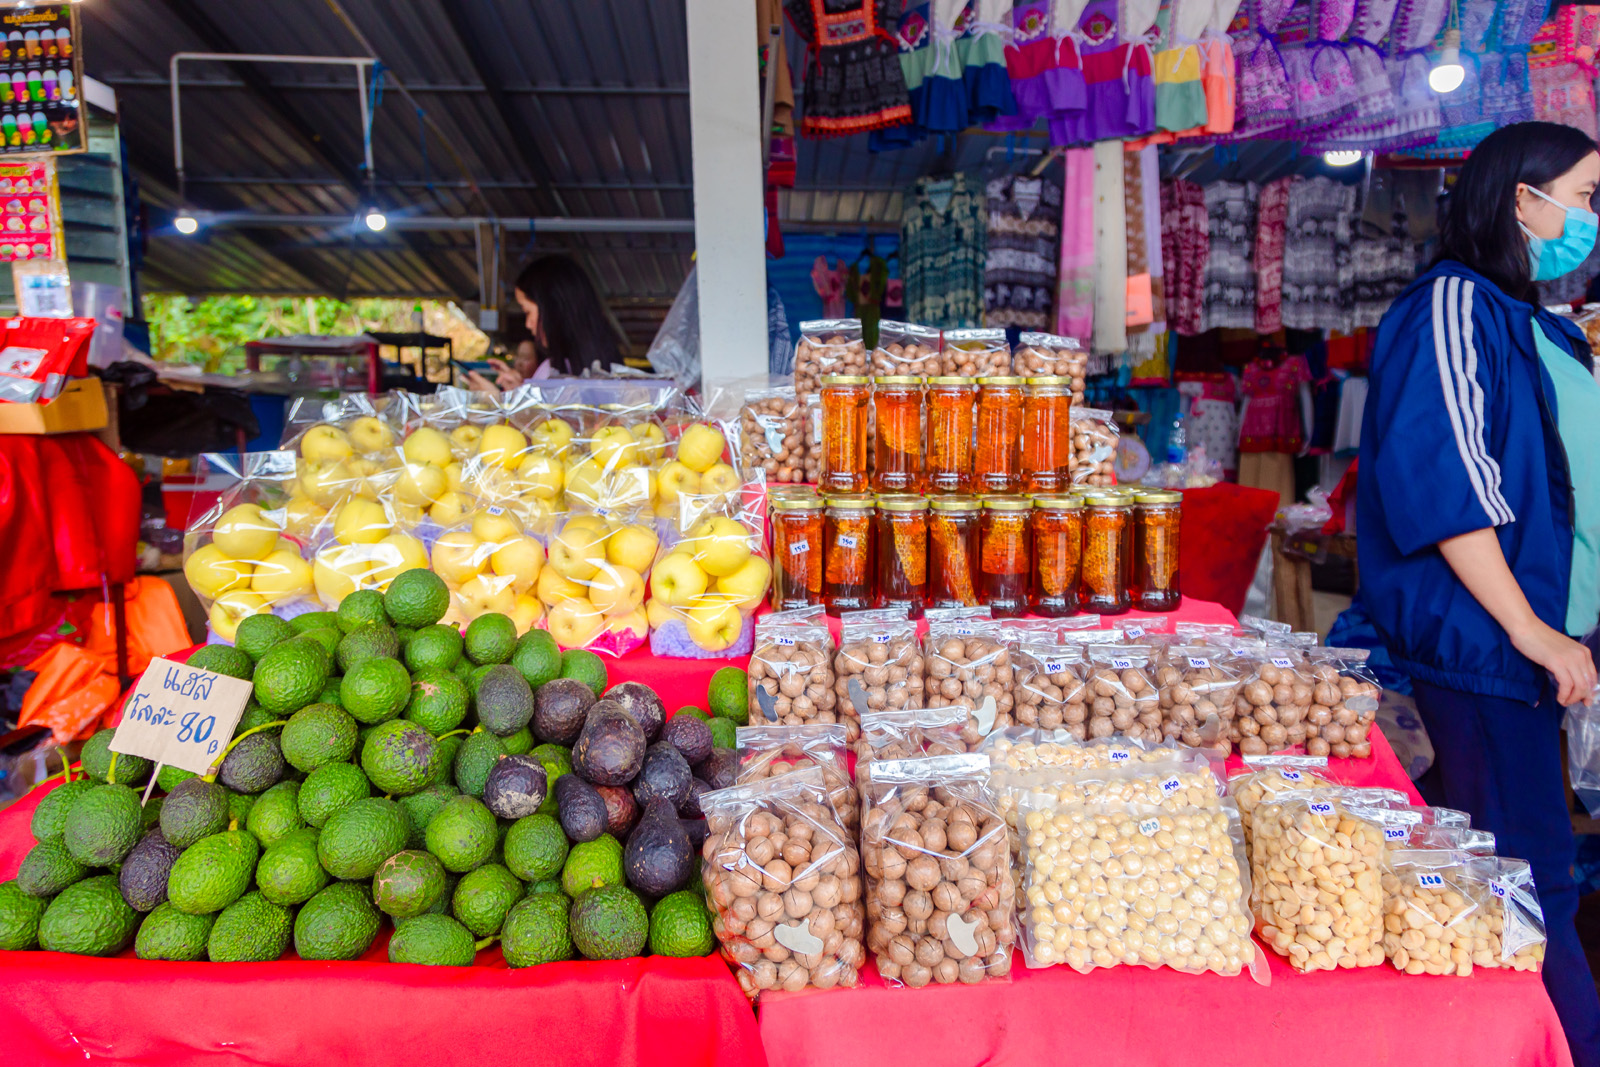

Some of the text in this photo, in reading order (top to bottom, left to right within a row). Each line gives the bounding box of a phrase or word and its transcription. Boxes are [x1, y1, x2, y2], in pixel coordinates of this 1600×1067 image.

[842, 538, 853, 546] 150
[794, 544, 806, 553] 150
[1047, 663, 1061, 672] 100
[1114, 660, 1129, 668] 100
[1191, 659, 1205, 667] 100
[1274, 659, 1289, 667] 100
[177, 712, 216, 743] 80
[1141, 821, 1158, 833] 600
[1386, 829, 1405, 838] 200
[1420, 875, 1442, 886] 200
